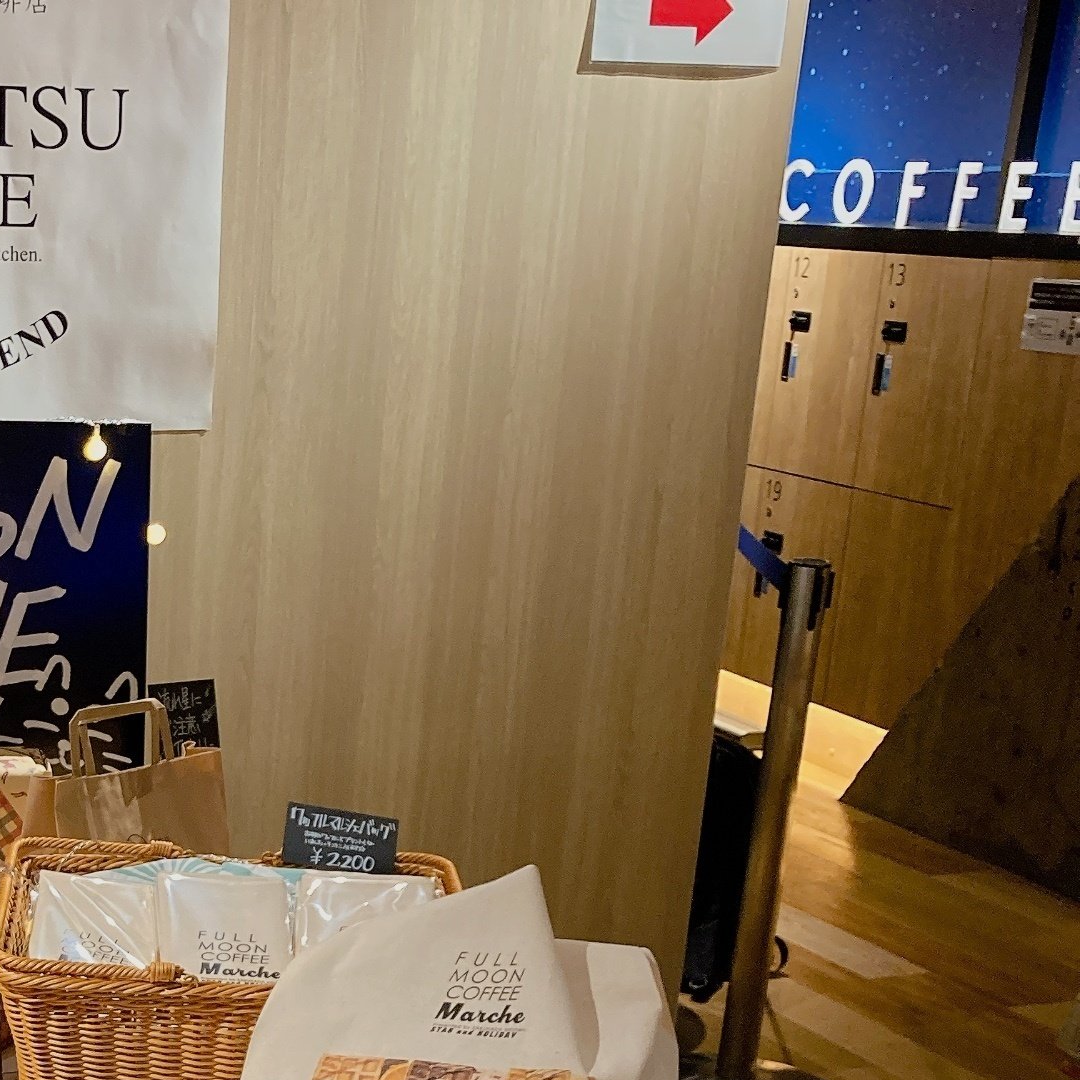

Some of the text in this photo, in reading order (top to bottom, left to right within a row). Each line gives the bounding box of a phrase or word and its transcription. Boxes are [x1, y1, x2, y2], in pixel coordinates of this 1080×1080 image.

[794, 255, 810, 280] 12
[887, 262, 907, 288] 13
[765, 478, 783, 502] 19
[309, 846, 376, 873] ¥2200
[198, 930, 257, 943] FULL
[198, 941, 268, 954] MOON
[201, 951, 271, 965] COFFEE
[454, 951, 518, 967] FULL
[199, 961, 281, 980] Marche
[448, 968, 526, 984] MOON
[446, 985, 523, 1001] COFFEE
[434, 1001, 526, 1024] Marche
